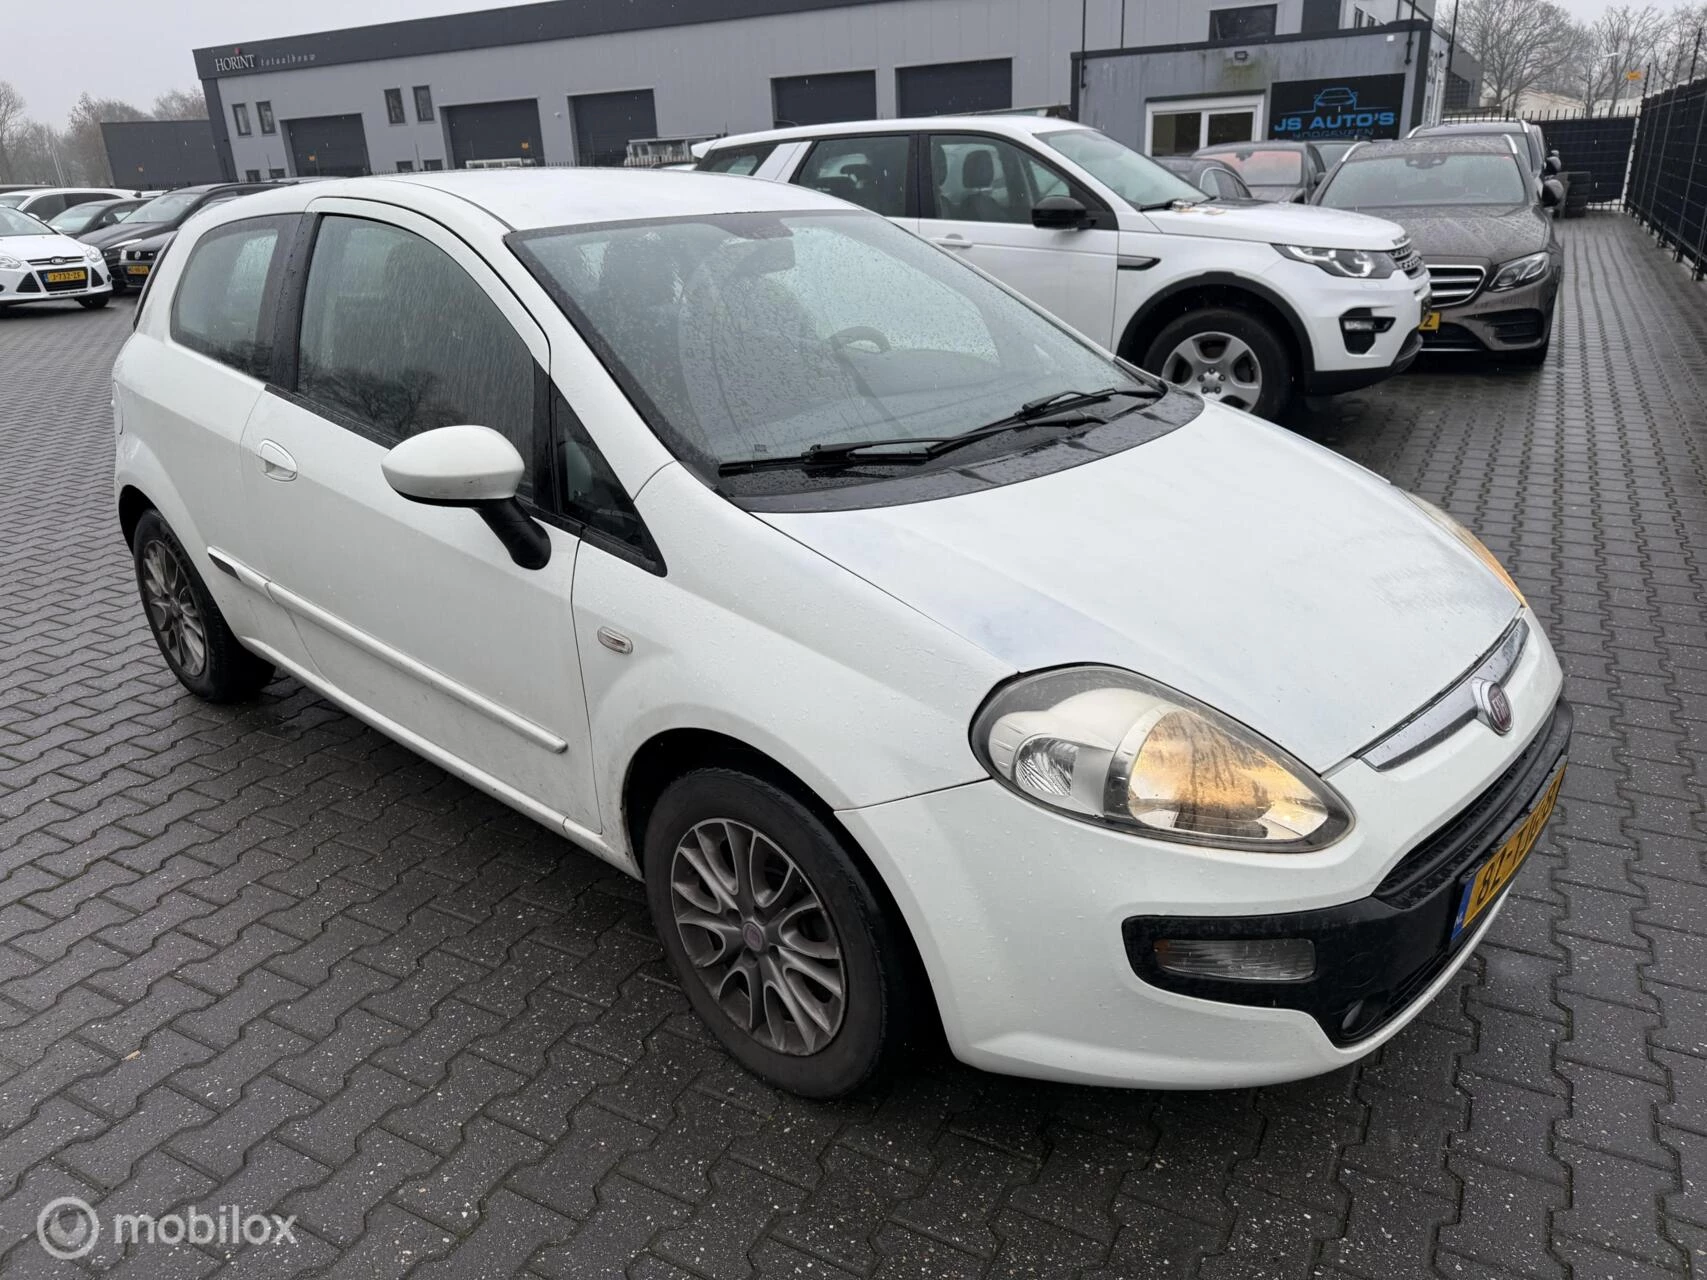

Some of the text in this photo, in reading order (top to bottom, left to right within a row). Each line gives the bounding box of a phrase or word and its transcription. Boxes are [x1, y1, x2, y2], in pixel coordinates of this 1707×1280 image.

[215, 54, 255, 71] HORINT
[1274, 112, 1395, 131] JS AUTO'S
